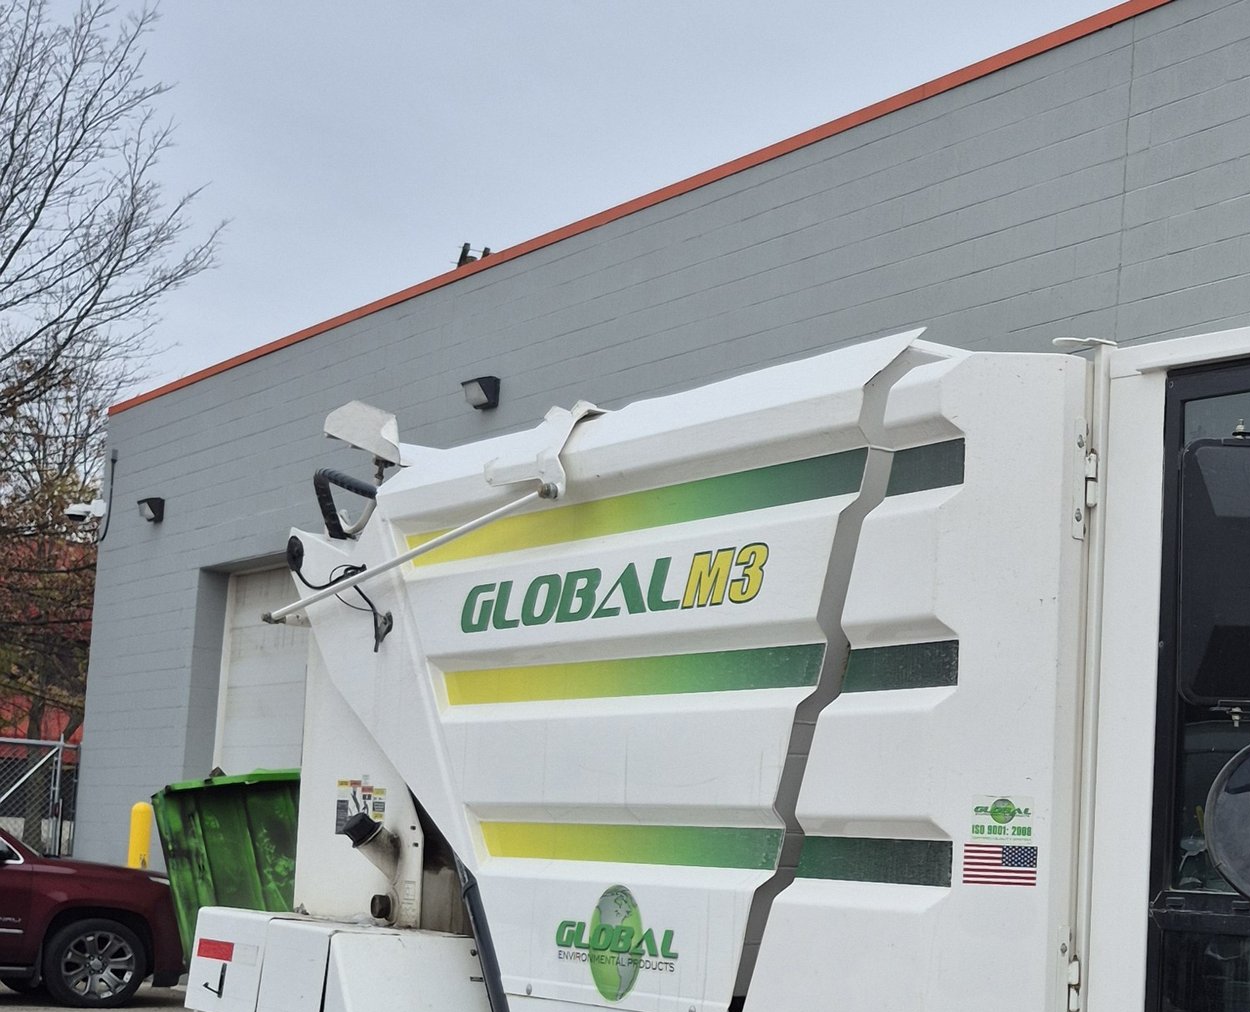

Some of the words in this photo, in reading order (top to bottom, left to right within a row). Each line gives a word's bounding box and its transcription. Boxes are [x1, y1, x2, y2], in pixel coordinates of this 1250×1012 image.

[460, 556, 681, 634] GLOBAL
[681, 542, 770, 609] M3
[973, 806, 1032, 815] GLOBAL
[972, 824, 985, 834] ISO
[987, 825, 1009, 836] 9001:
[556, 920, 679, 959] GLOBAL
[558, 950, 625, 967] ENVIRONMENTAL
[628, 958, 675, 972] PRODUCTS
